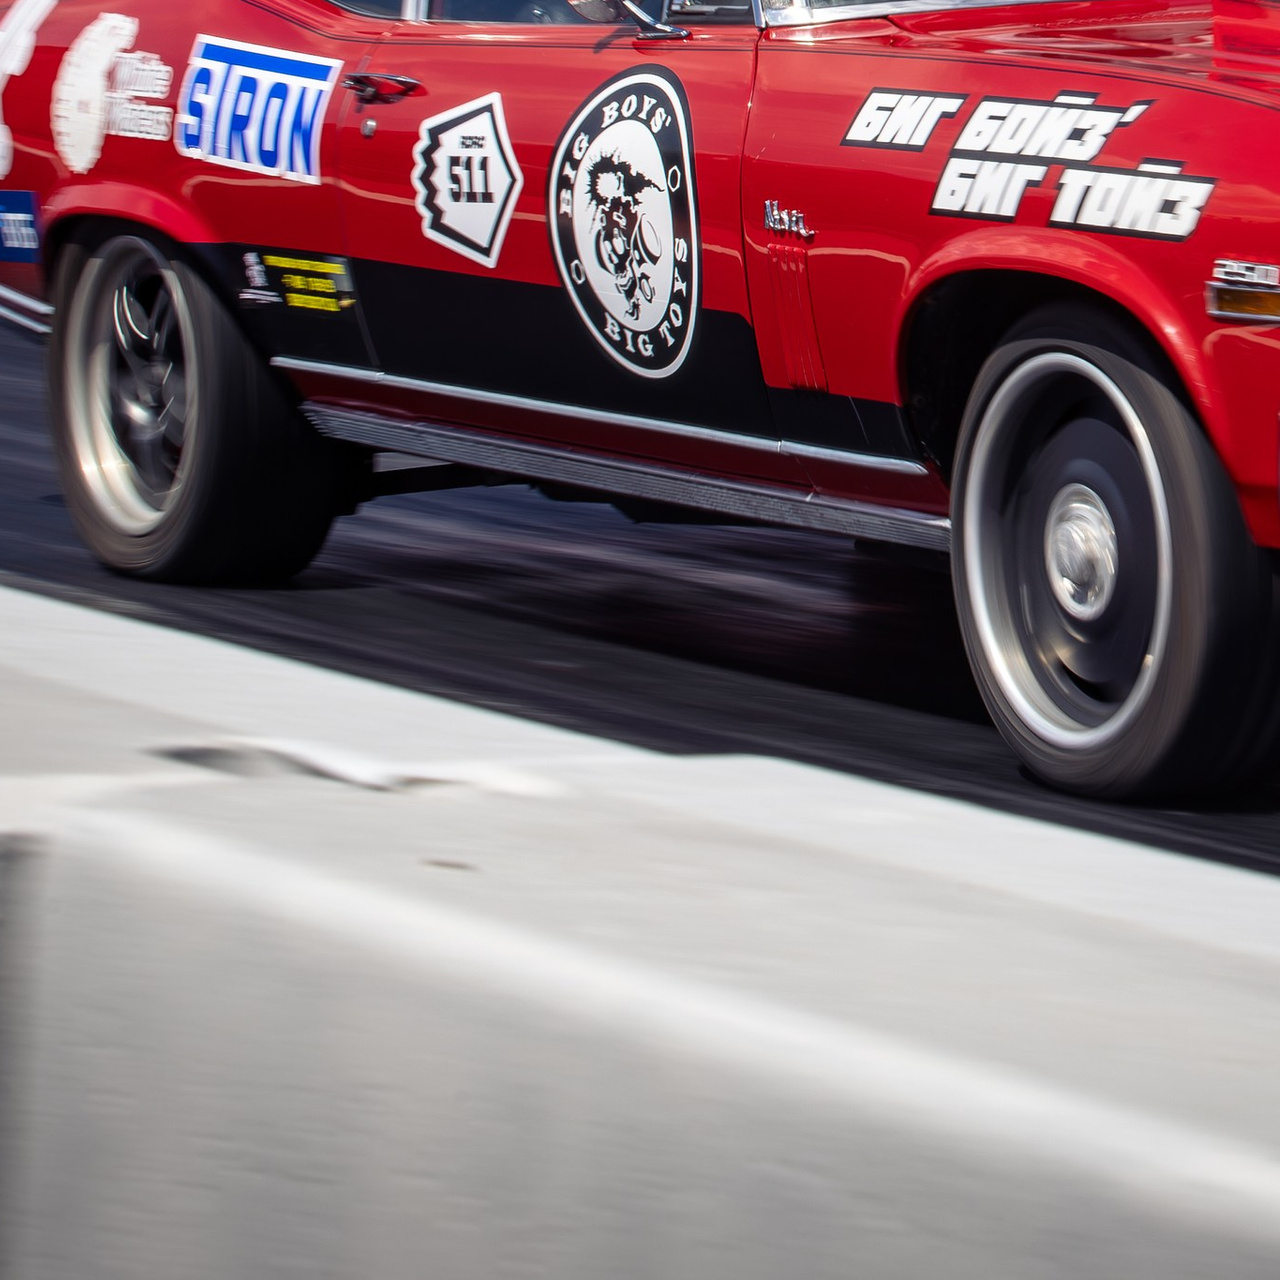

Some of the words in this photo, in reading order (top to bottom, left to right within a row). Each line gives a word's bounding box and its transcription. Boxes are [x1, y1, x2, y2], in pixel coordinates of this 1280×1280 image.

[846, 93, 964, 146] БИГ
[447, 156, 496, 203] 511
[560, 131, 590, 218] BIG
[931, 158, 1048, 217] БИГ
[604, 312, 655, 358] BIG
[659, 238, 688, 347] TOYS
